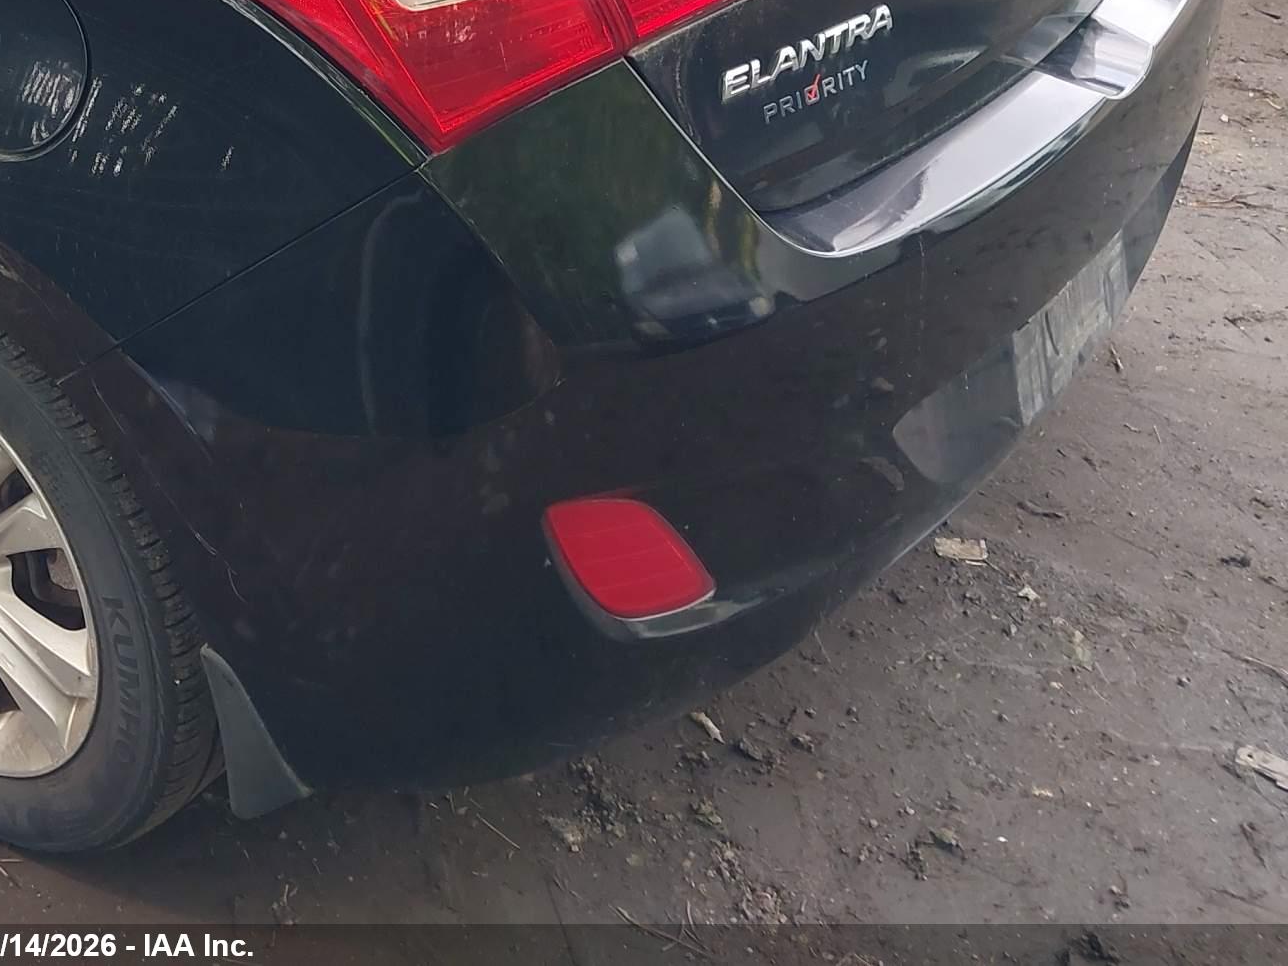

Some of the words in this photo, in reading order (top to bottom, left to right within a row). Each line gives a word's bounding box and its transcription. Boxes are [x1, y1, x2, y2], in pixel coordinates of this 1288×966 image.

[721, 3, 894, 103] ELANTRA
[763, 60, 869, 124] PRIORITY
[102, 596, 142, 763] KUMHO
